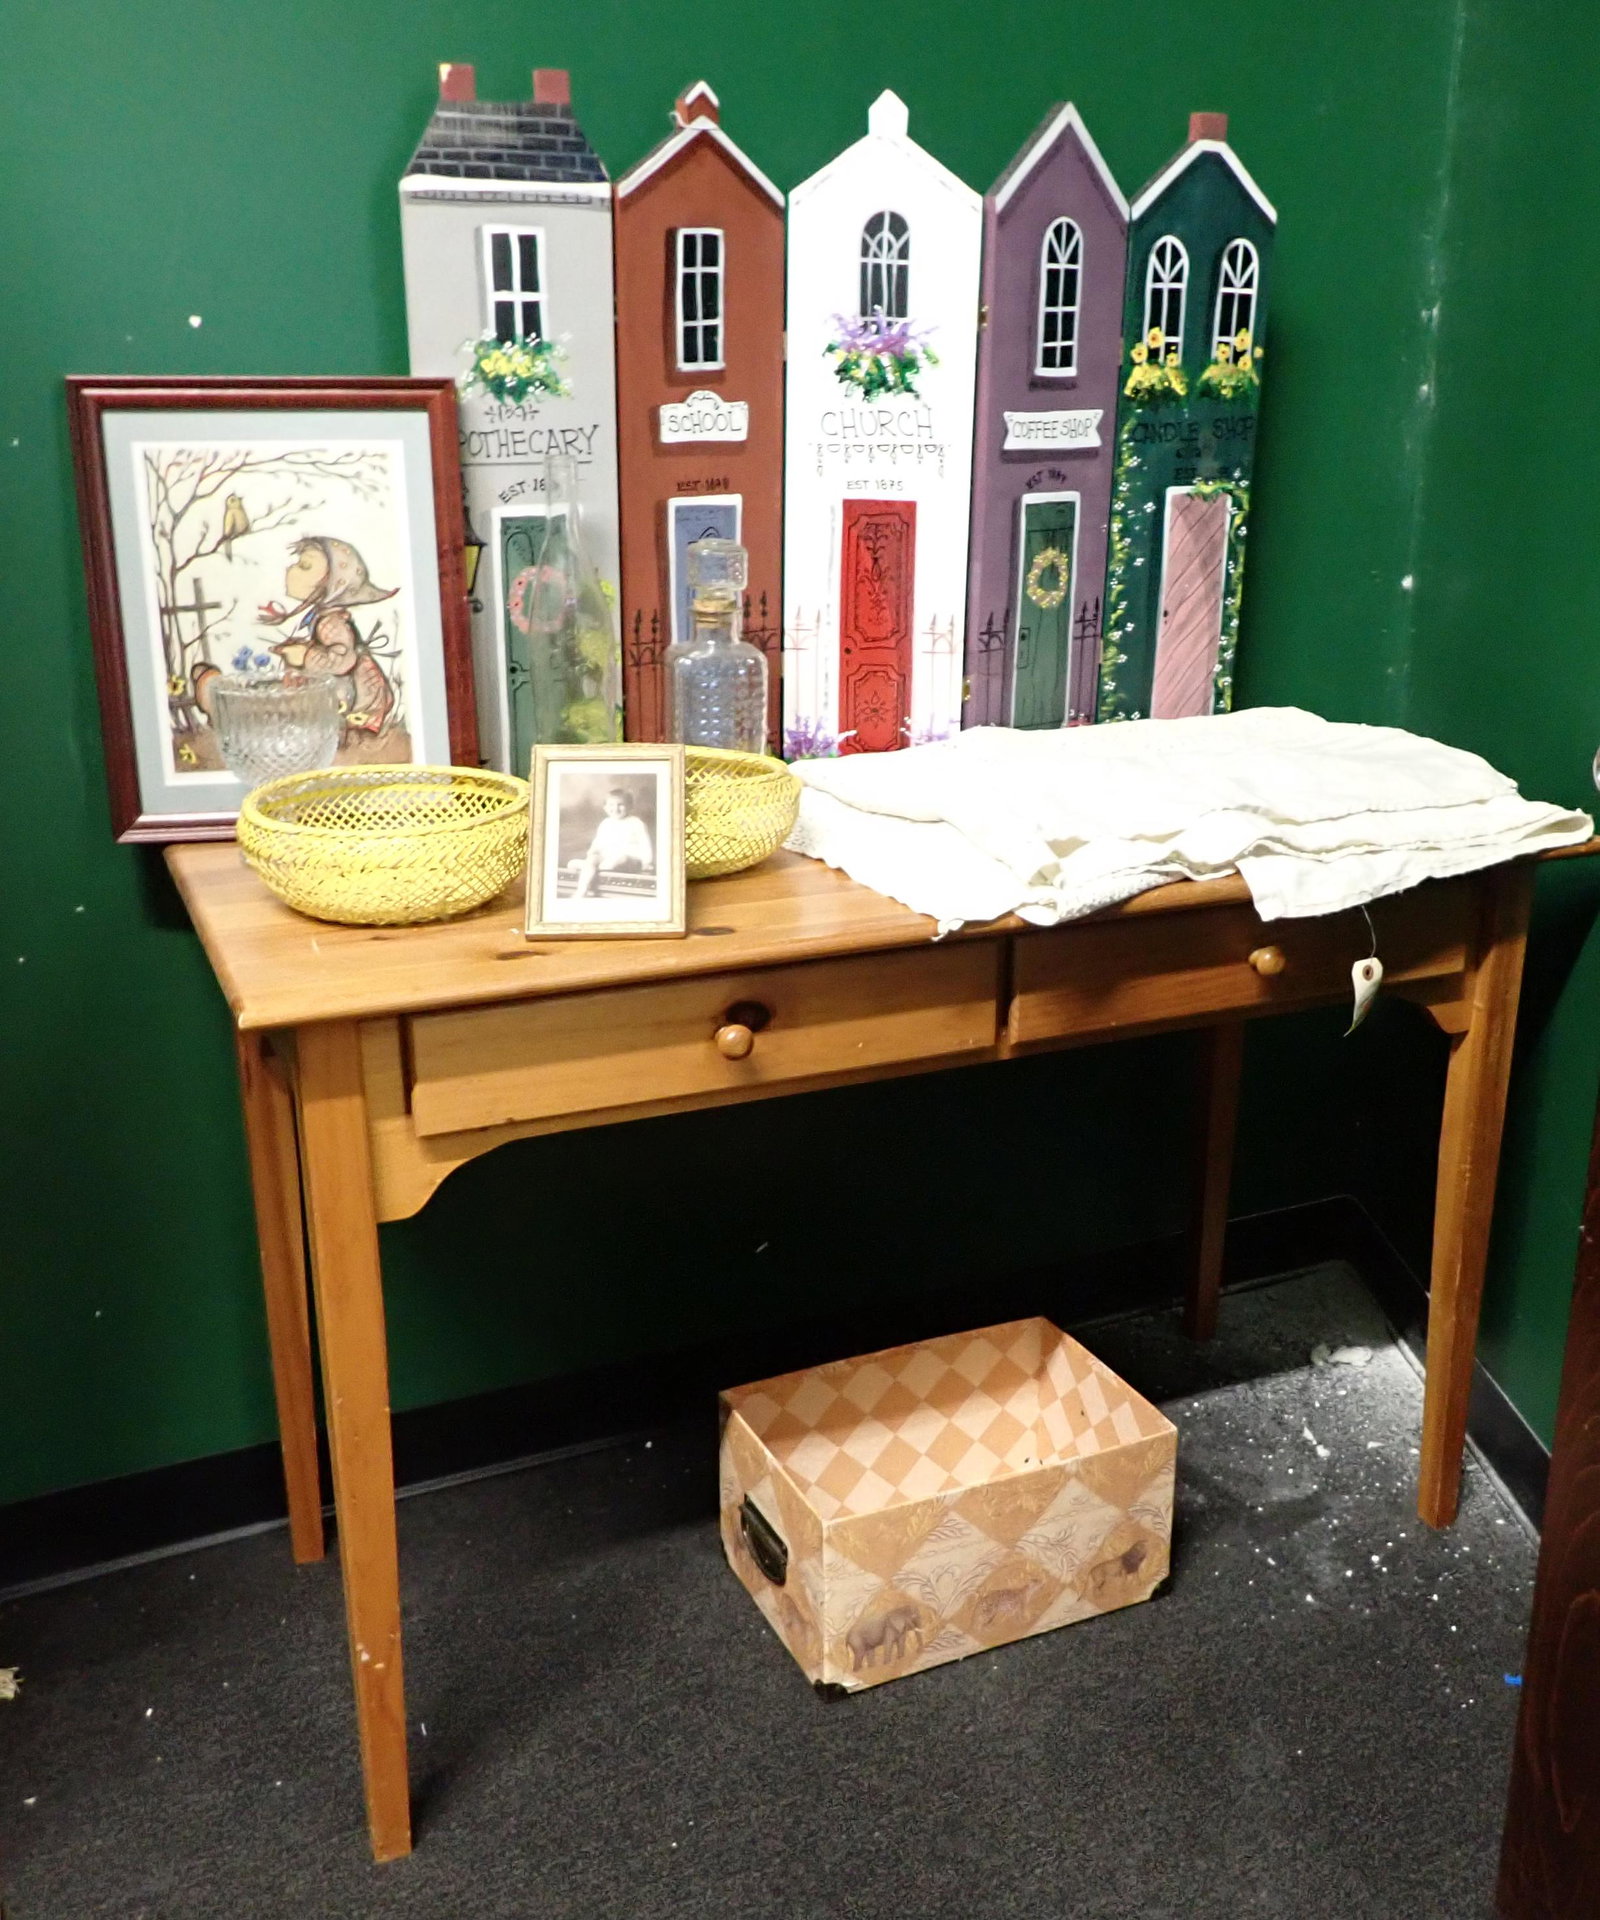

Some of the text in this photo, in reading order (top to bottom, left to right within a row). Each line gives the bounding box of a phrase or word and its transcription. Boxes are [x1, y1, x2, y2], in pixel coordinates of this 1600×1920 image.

[668, 410, 742, 434] SCHOOL
[820, 407, 933, 439] CHURCH
[1012, 417, 1092, 439] COFFEE SHOP
[459, 424, 600, 458] POTHECARY
[846, 480, 870, 490] EST
